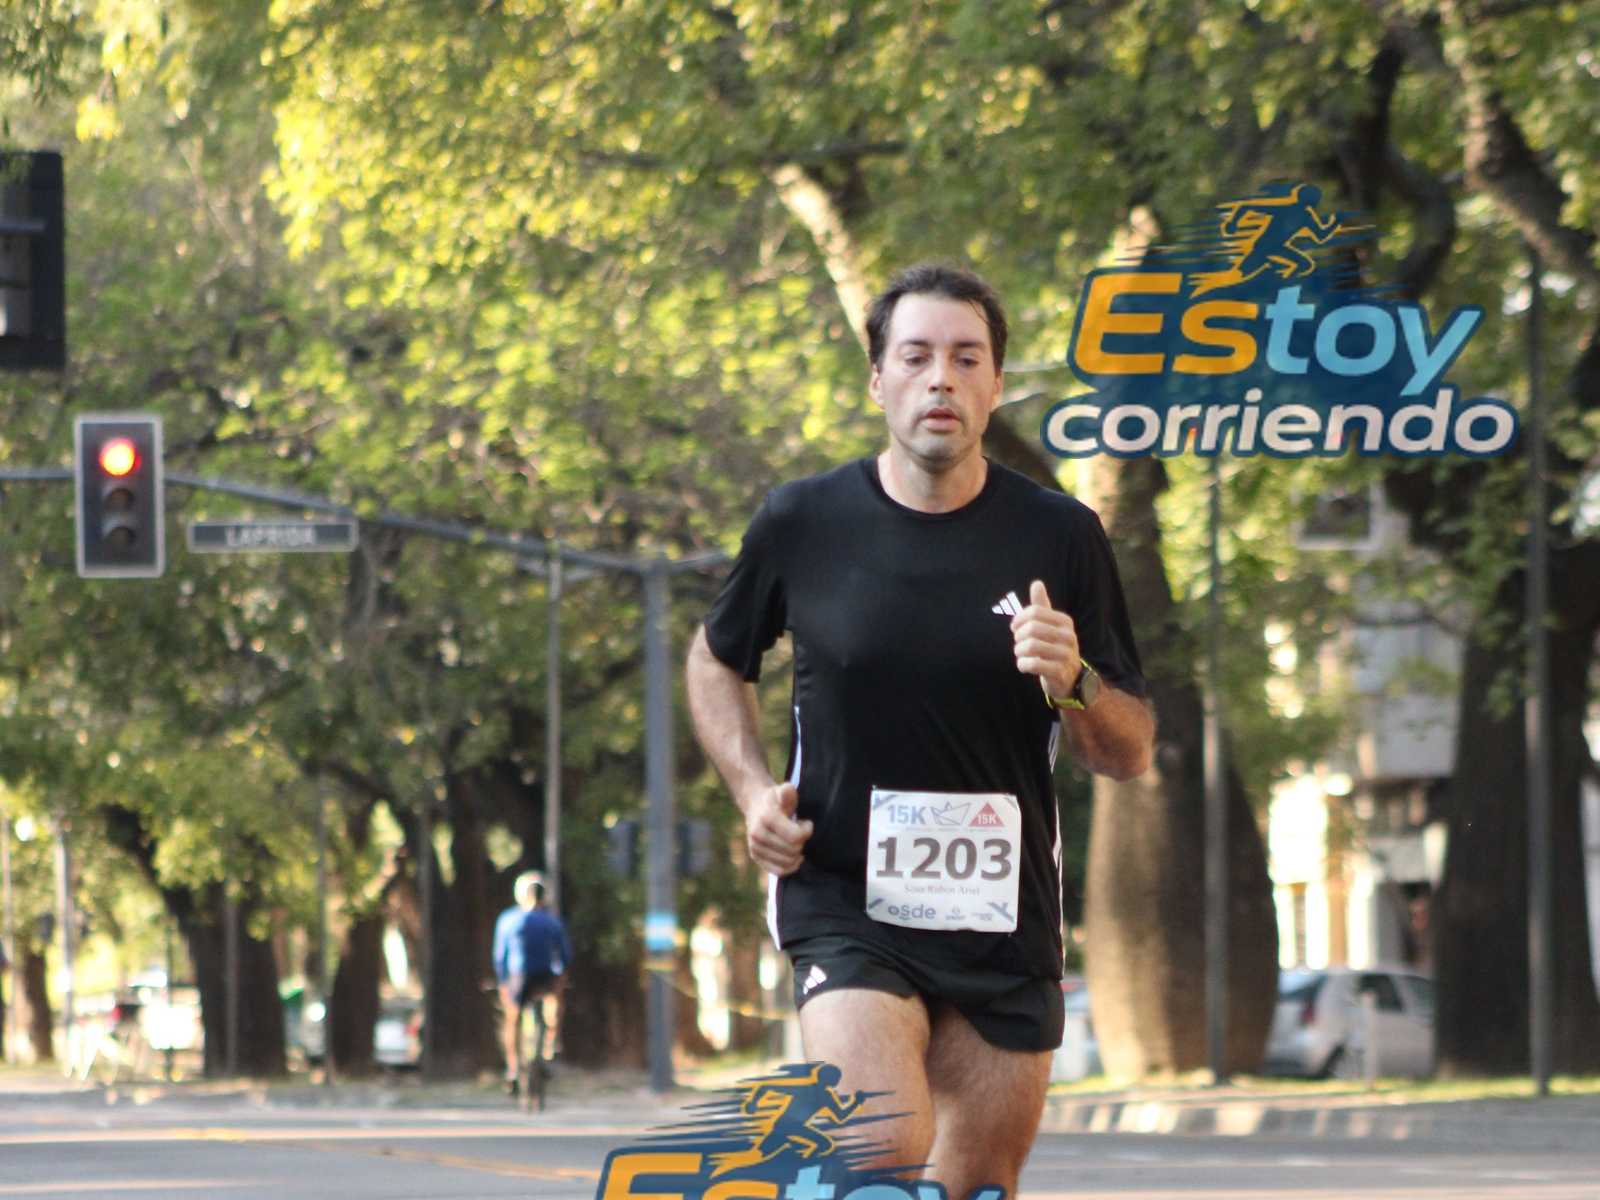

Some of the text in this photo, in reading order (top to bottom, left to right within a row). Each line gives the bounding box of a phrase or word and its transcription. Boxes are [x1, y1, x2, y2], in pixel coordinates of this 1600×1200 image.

[887, 804, 927, 825] 15K
[977, 815, 997, 825] 15K
[876, 836, 1012, 882] 1203
[888, 903, 936, 920] osde
